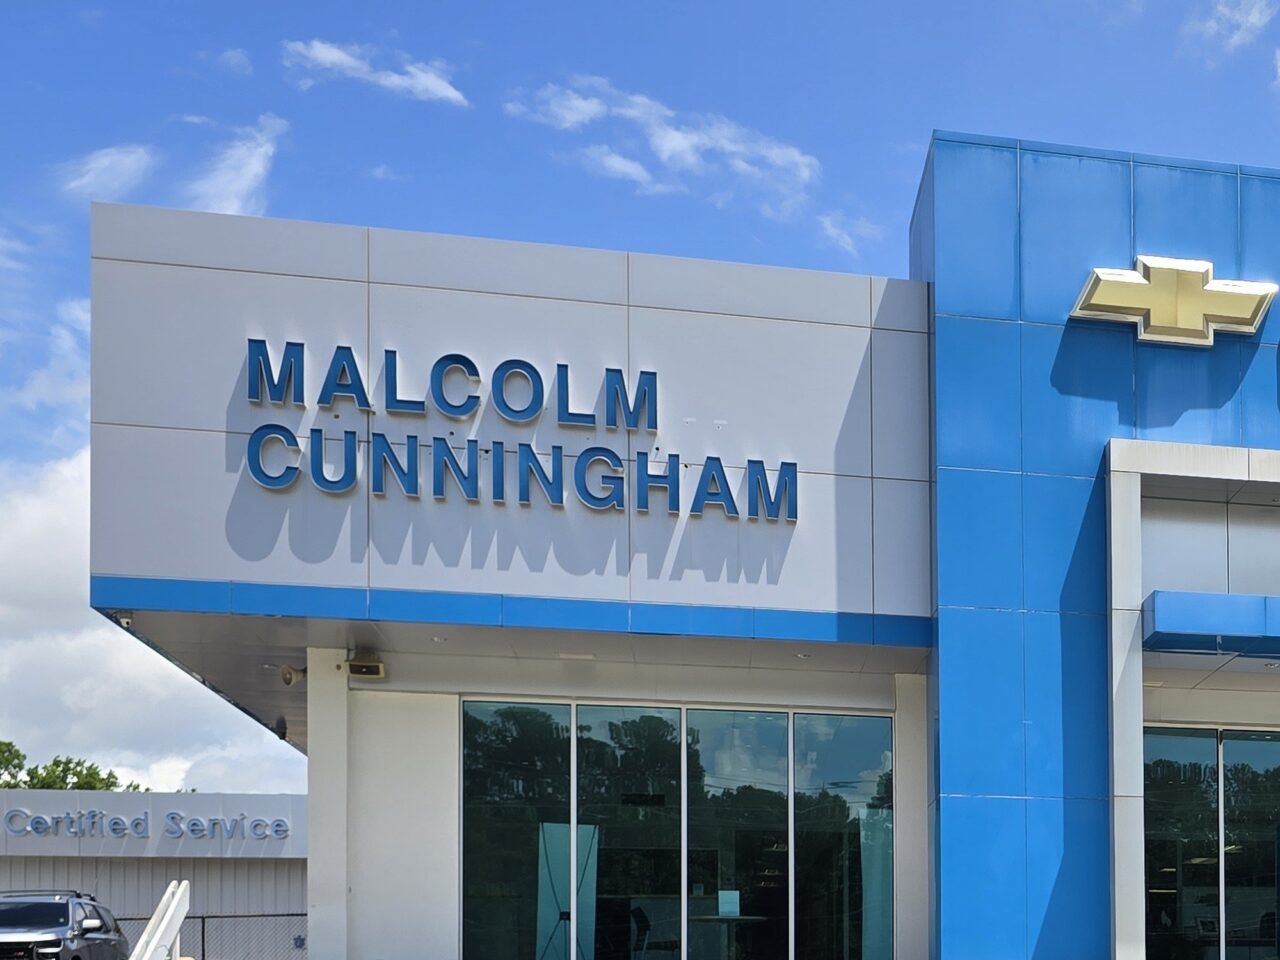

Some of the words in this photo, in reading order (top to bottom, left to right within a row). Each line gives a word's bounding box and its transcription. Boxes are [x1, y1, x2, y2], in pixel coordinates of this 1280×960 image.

[247, 337, 658, 431] MALCOLM
[247, 423, 798, 521] CUNNINGHAM
[4, 808, 150, 838] Certified
[164, 811, 290, 840] Service
